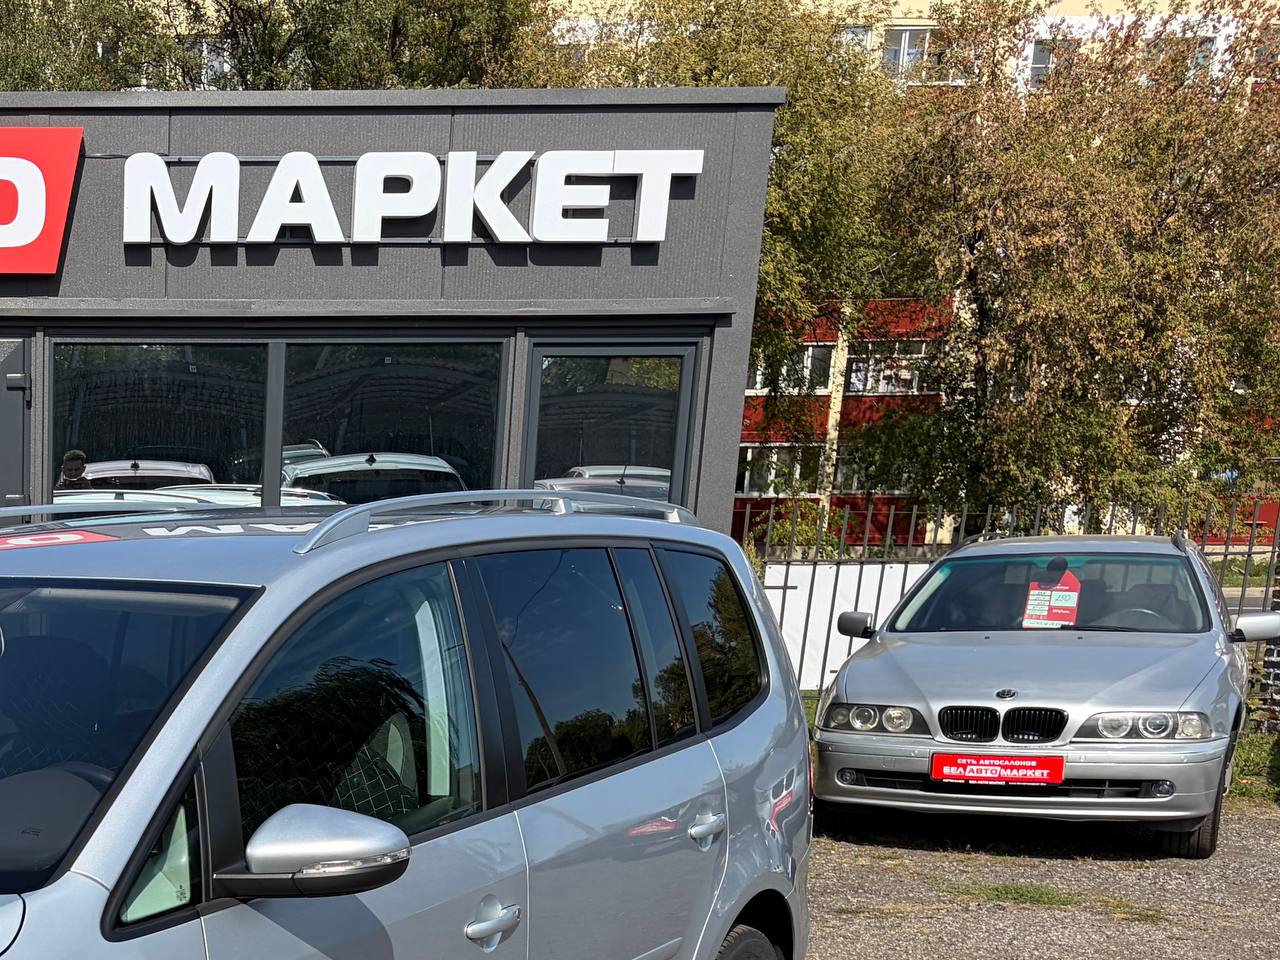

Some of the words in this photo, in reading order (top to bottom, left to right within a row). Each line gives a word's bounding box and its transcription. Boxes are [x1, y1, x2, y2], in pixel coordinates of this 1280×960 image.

[122, 150, 704, 245] МАРКЕТ
[979, 759, 1037, 767] АВТОСАЛОНОВ
[943, 766, 965, 775] БЕЛ
[967, 767, 999, 776] АВТО
[1000, 768, 1050, 777] МАРКЕТ
